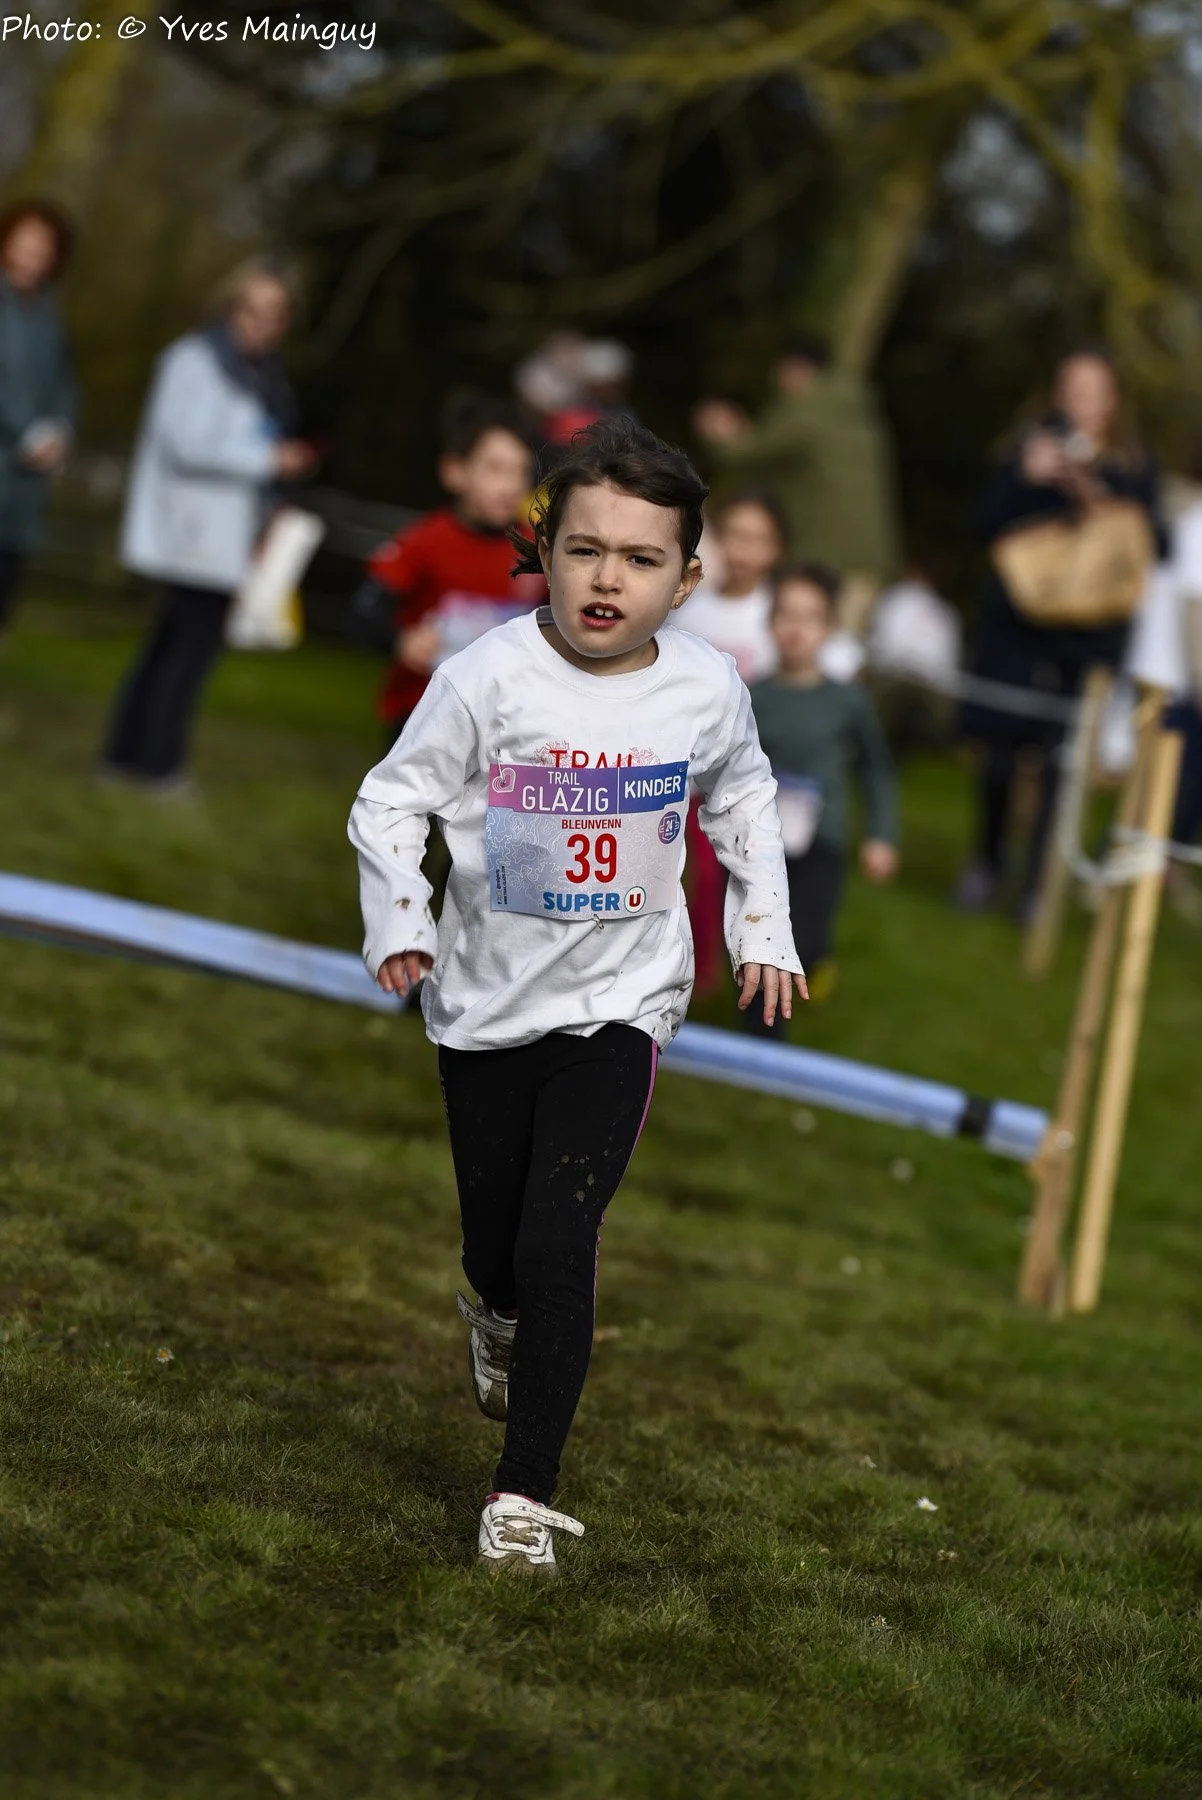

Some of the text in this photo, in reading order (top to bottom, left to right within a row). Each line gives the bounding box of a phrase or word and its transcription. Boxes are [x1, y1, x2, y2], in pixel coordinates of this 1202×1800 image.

[547, 771, 580, 786] TRAIL
[624, 775, 682, 799] KINDER
[522, 785, 609, 813] GLAZIG
[561, 818, 622, 830] BLEUNVENN
[565, 833, 617, 884] 39
[543, 892, 641, 912] SUPER U
